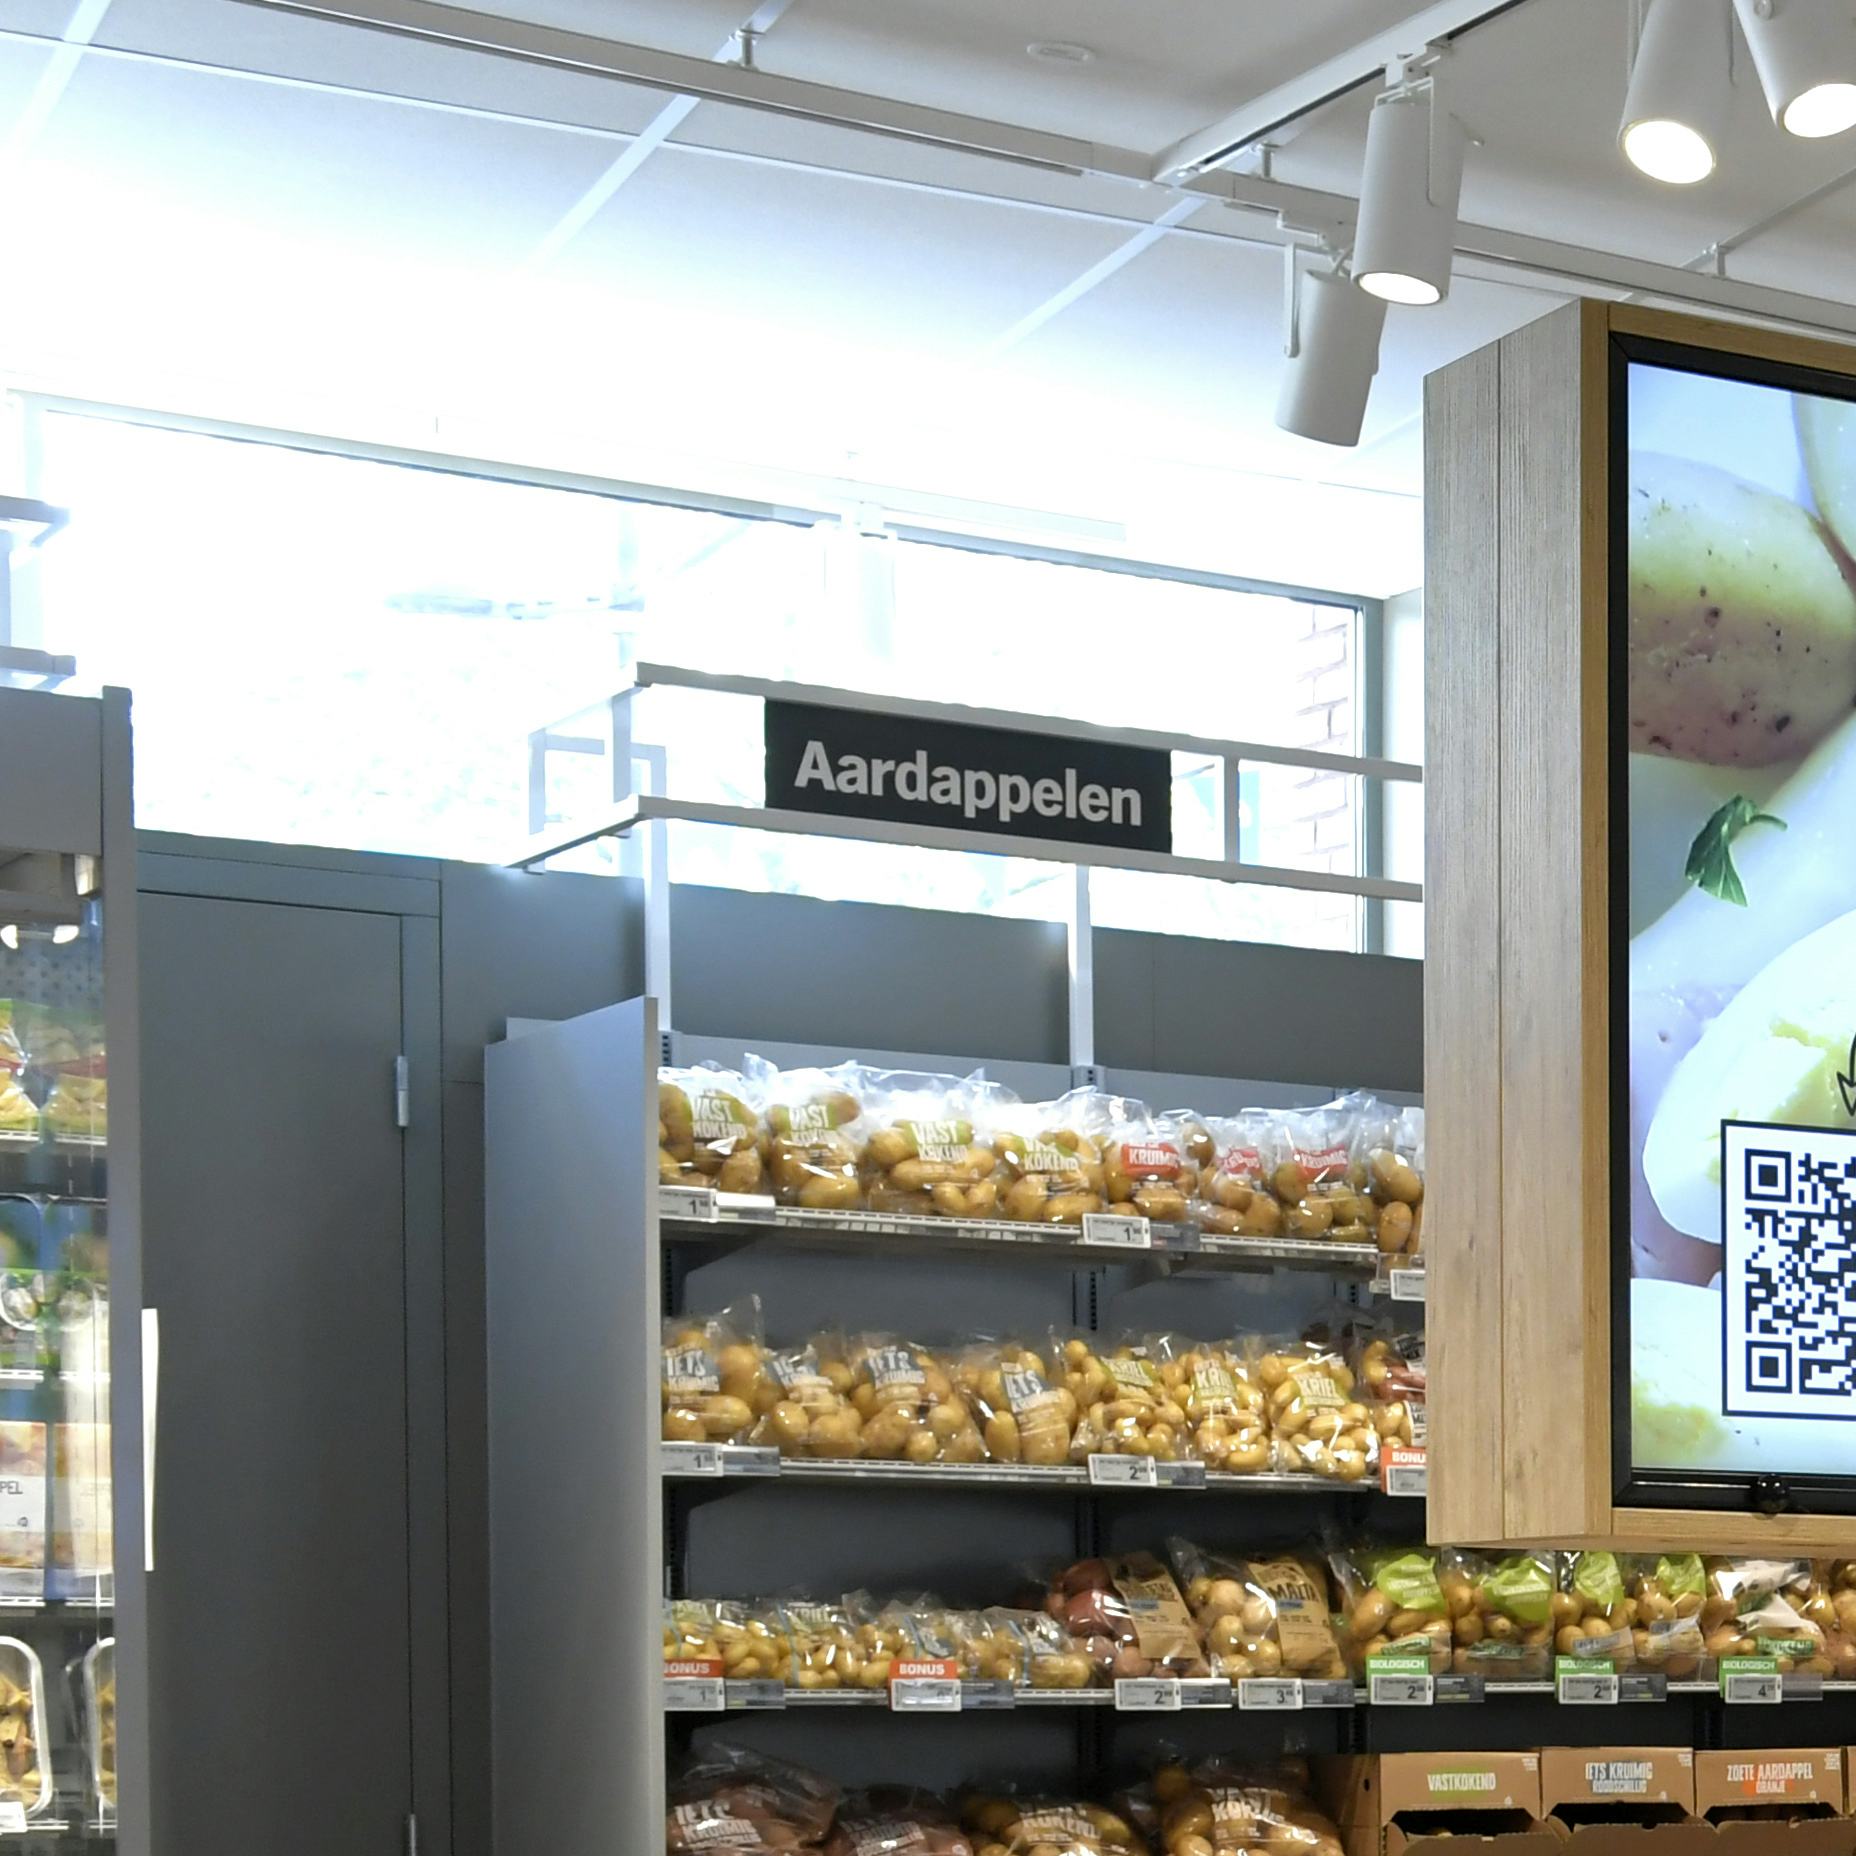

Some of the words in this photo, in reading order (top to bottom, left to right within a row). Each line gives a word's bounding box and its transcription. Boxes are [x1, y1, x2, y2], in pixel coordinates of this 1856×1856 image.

[794, 740, 1142, 827] Aardappelen
[899, 1662, 945, 1675] BONUS
[1370, 1659, 1424, 1669] BIOLOGISCH
[1722, 1660, 1775, 1670] BIOLOGISCH
[1585, 1762, 1606, 1780] IETS
[1609, 1762, 1653, 1780] KRUIMIG
[1727, 1764, 1754, 1782] ZOETE
[1758, 1763, 1813, 1781] AARDAPPEL
[1427, 1772, 1496, 1791] VASTKOKEND
